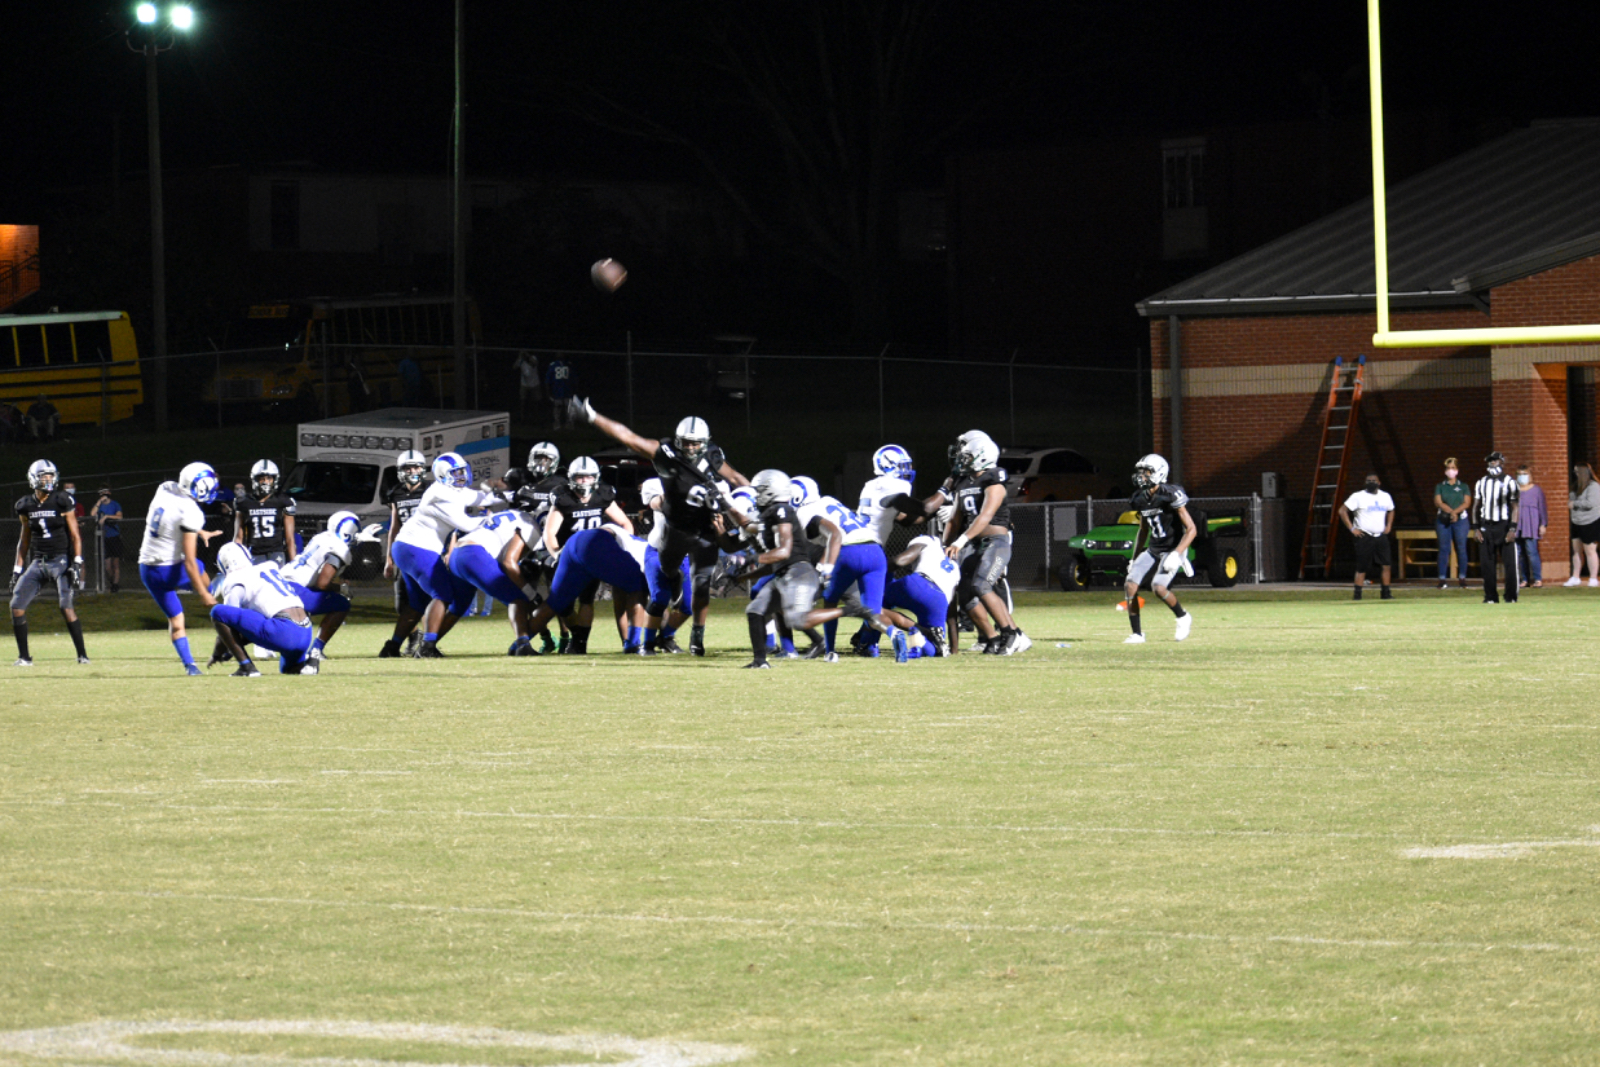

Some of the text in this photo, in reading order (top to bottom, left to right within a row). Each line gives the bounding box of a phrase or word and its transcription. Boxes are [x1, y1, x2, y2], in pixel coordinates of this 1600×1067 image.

[554, 366, 569, 379] 80
[472, 468, 491, 482] EMS
[249, 508, 277, 516] EASTSIDE
[777, 507, 786, 518] 4
[963, 496, 978, 515] 9
[572, 508, 602, 518] EASTSIDE
[38, 518, 52, 538] 1
[251, 516, 275, 538] 15
[1147, 515, 1166, 538] 11
